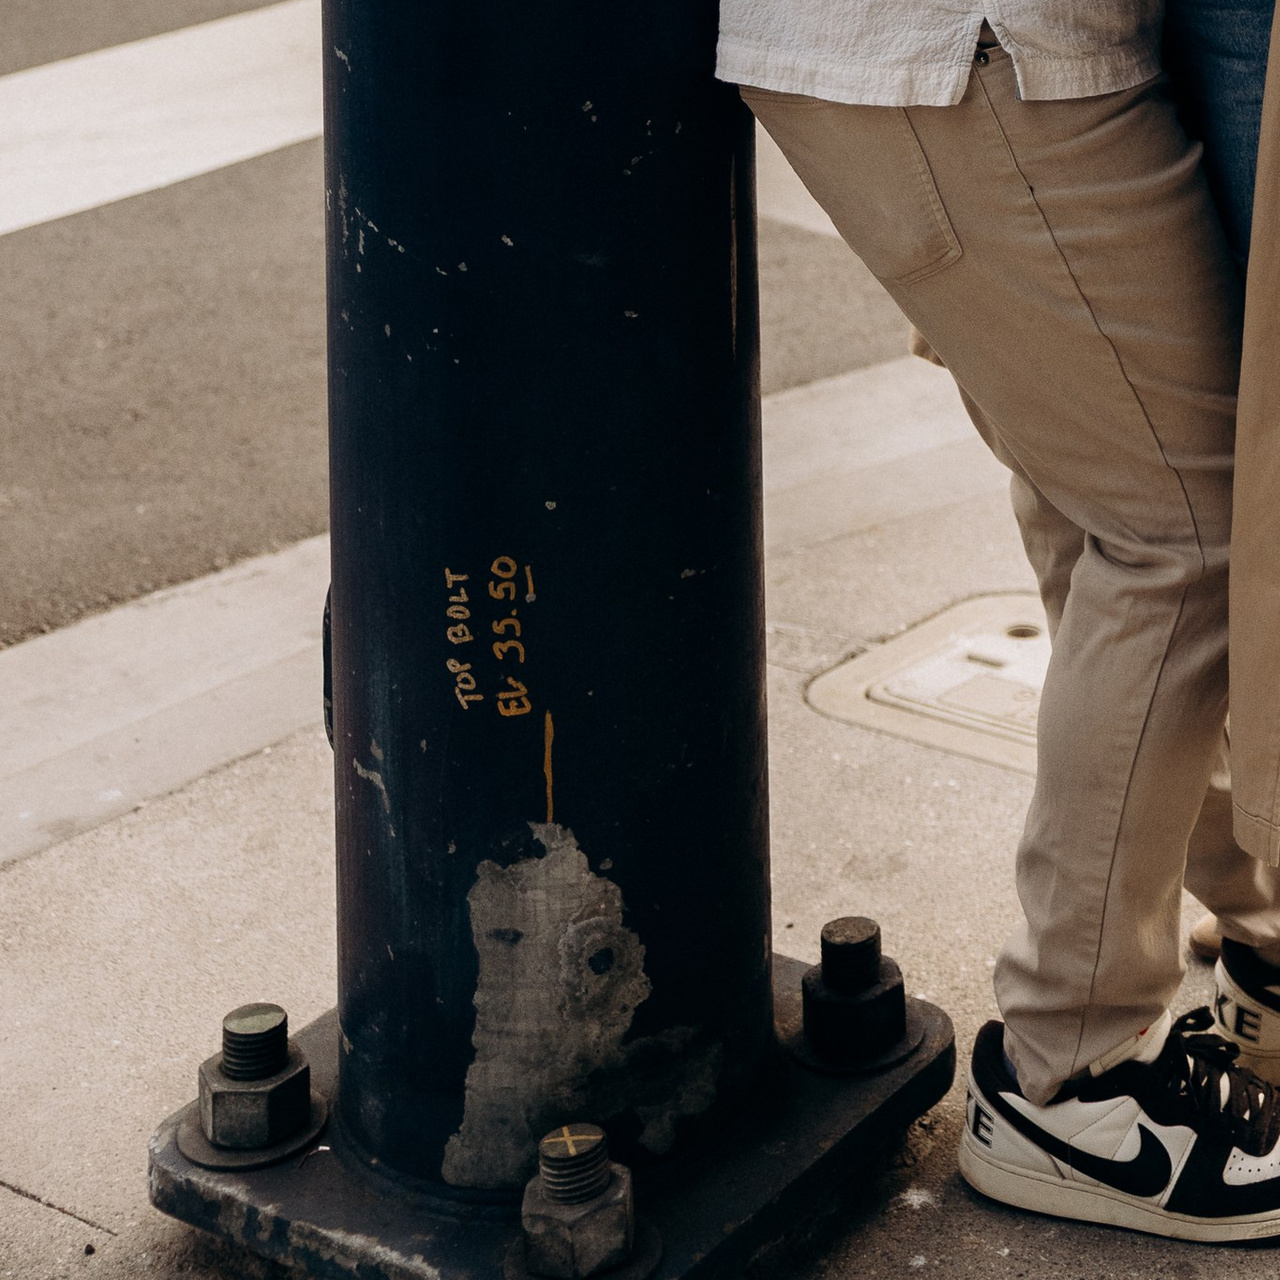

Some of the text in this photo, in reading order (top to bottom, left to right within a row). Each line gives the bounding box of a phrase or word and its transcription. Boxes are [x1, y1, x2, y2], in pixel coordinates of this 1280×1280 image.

[445, 567, 484, 710] TOP BOLT
[488, 555, 526, 664] 35.50
